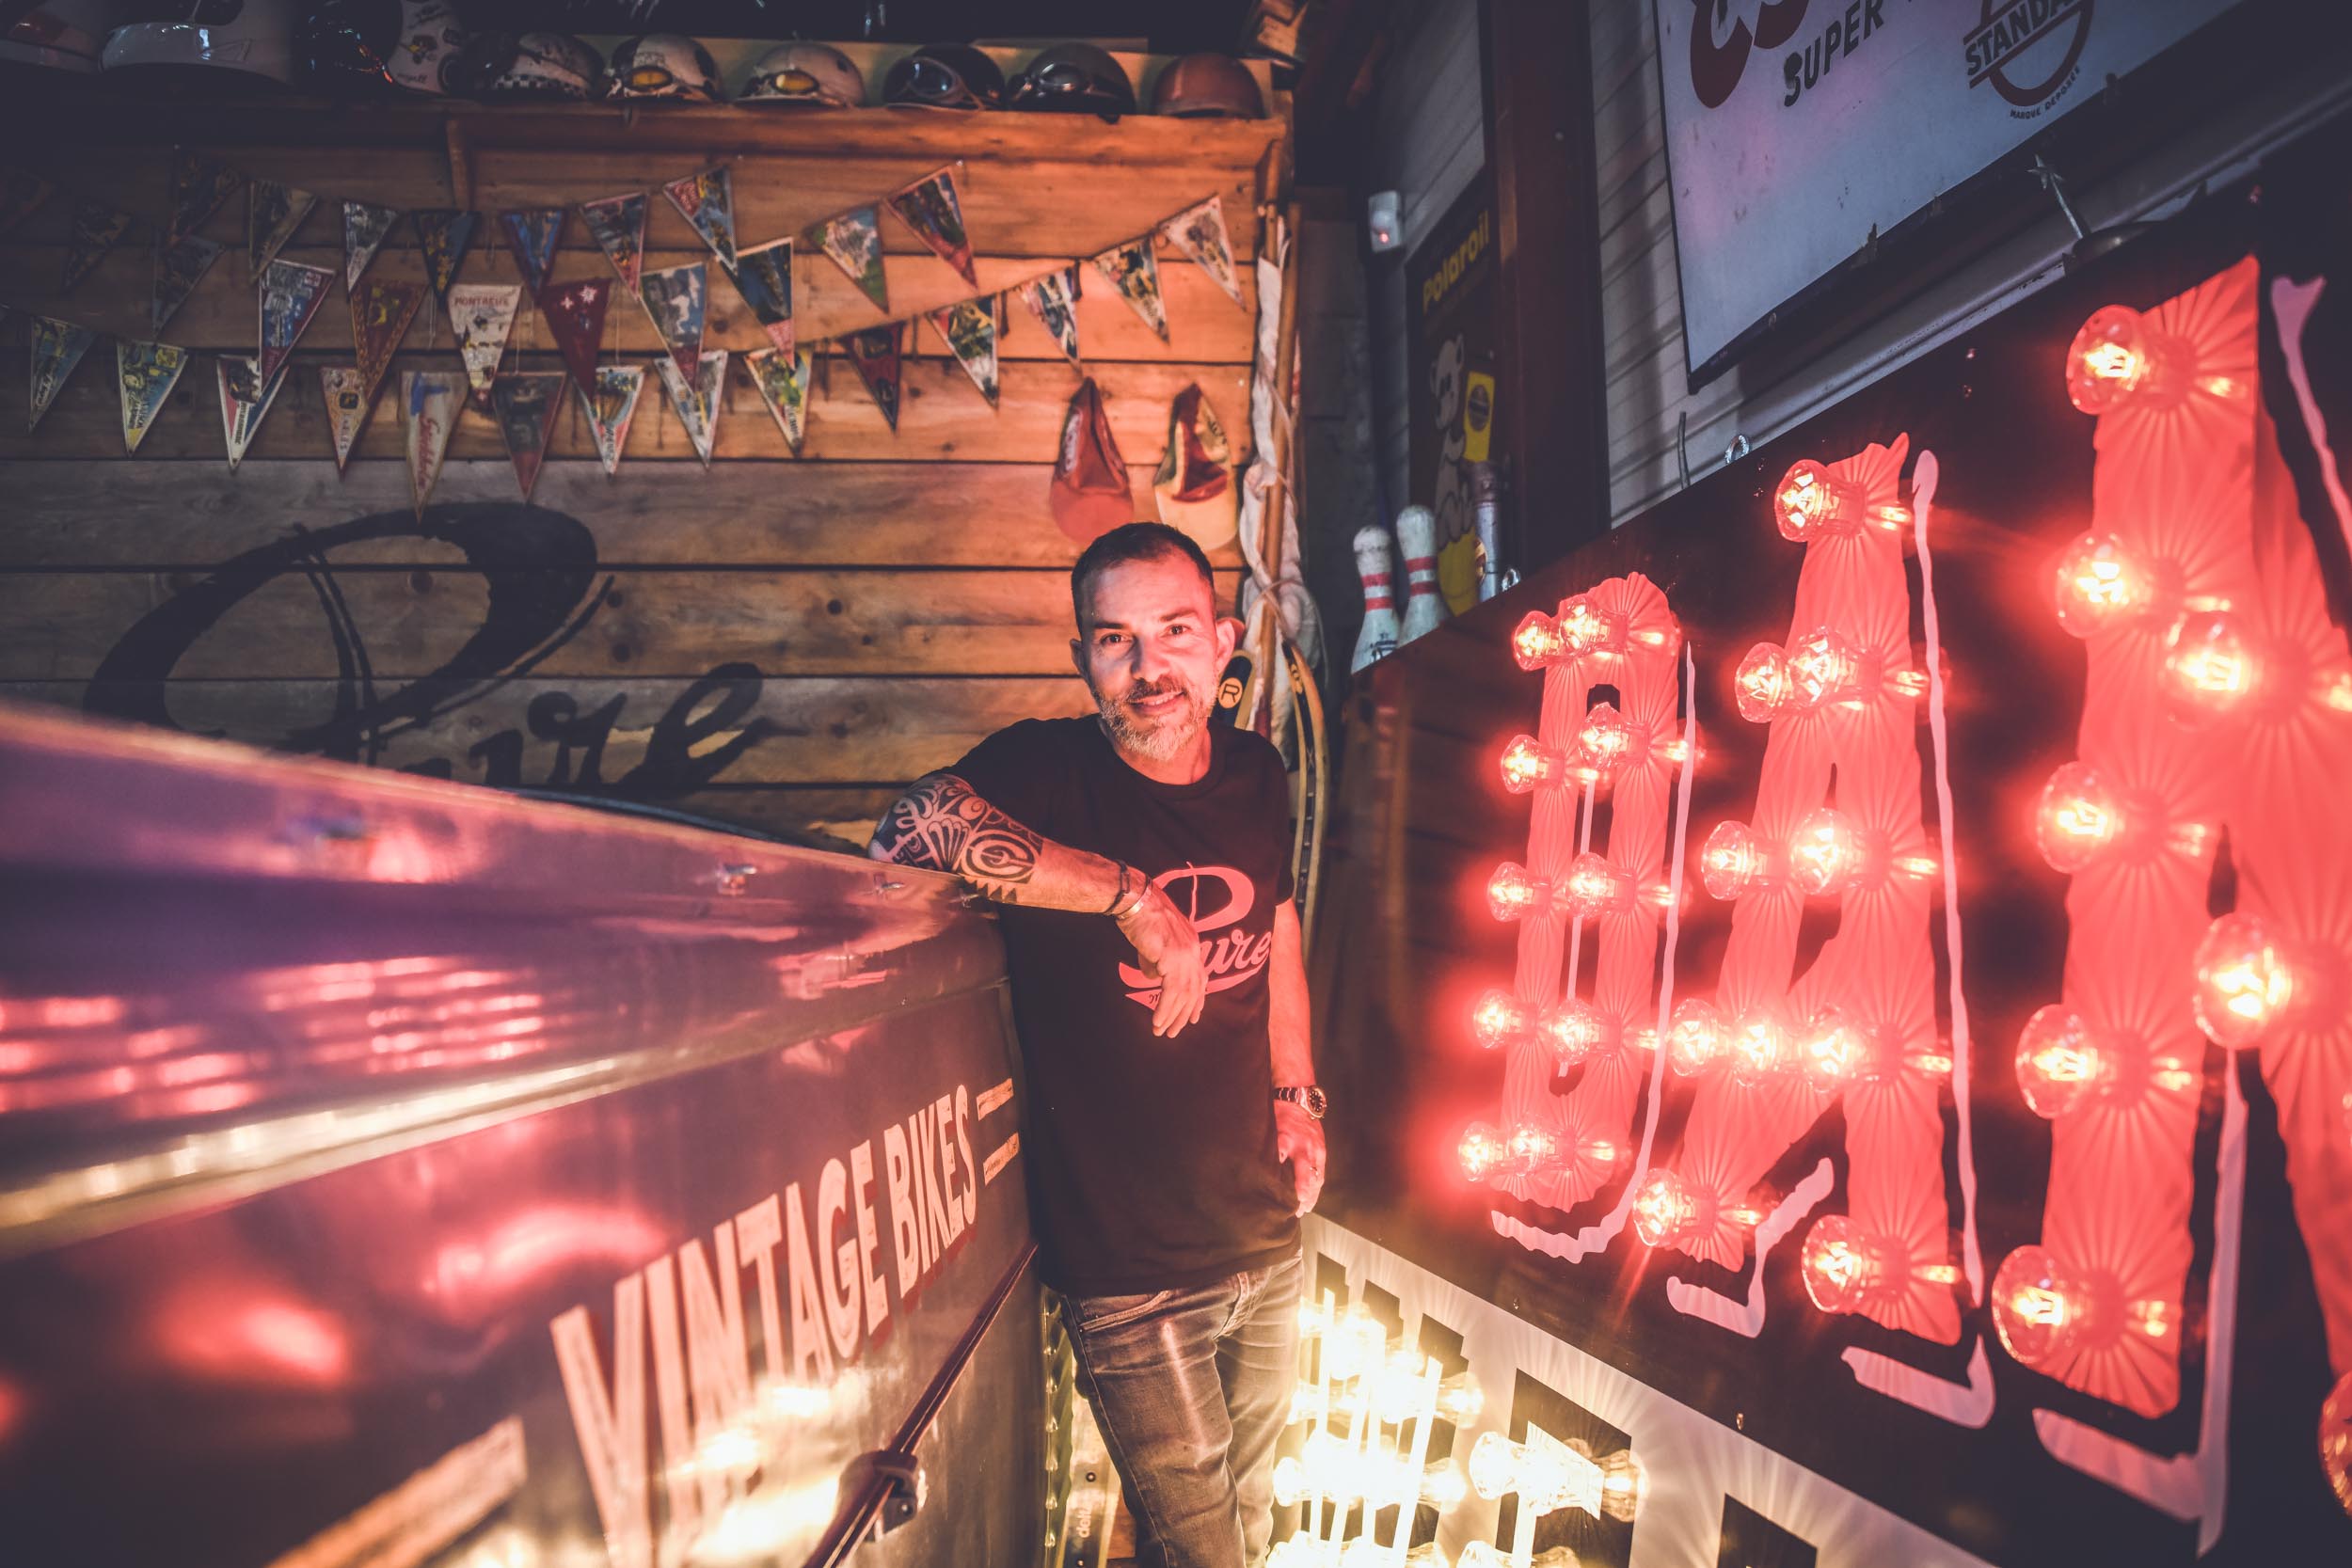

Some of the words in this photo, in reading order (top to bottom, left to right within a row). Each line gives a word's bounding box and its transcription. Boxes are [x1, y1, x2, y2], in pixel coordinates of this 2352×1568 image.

[1783, 0, 1884, 107] SUPER
[2010, 108, 2042, 119] MARQUE
[1422, 209, 1491, 316] Polaroil
[549, 1139, 889, 1568] VINTAGE
[882, 1084, 977, 1300] BIKES
